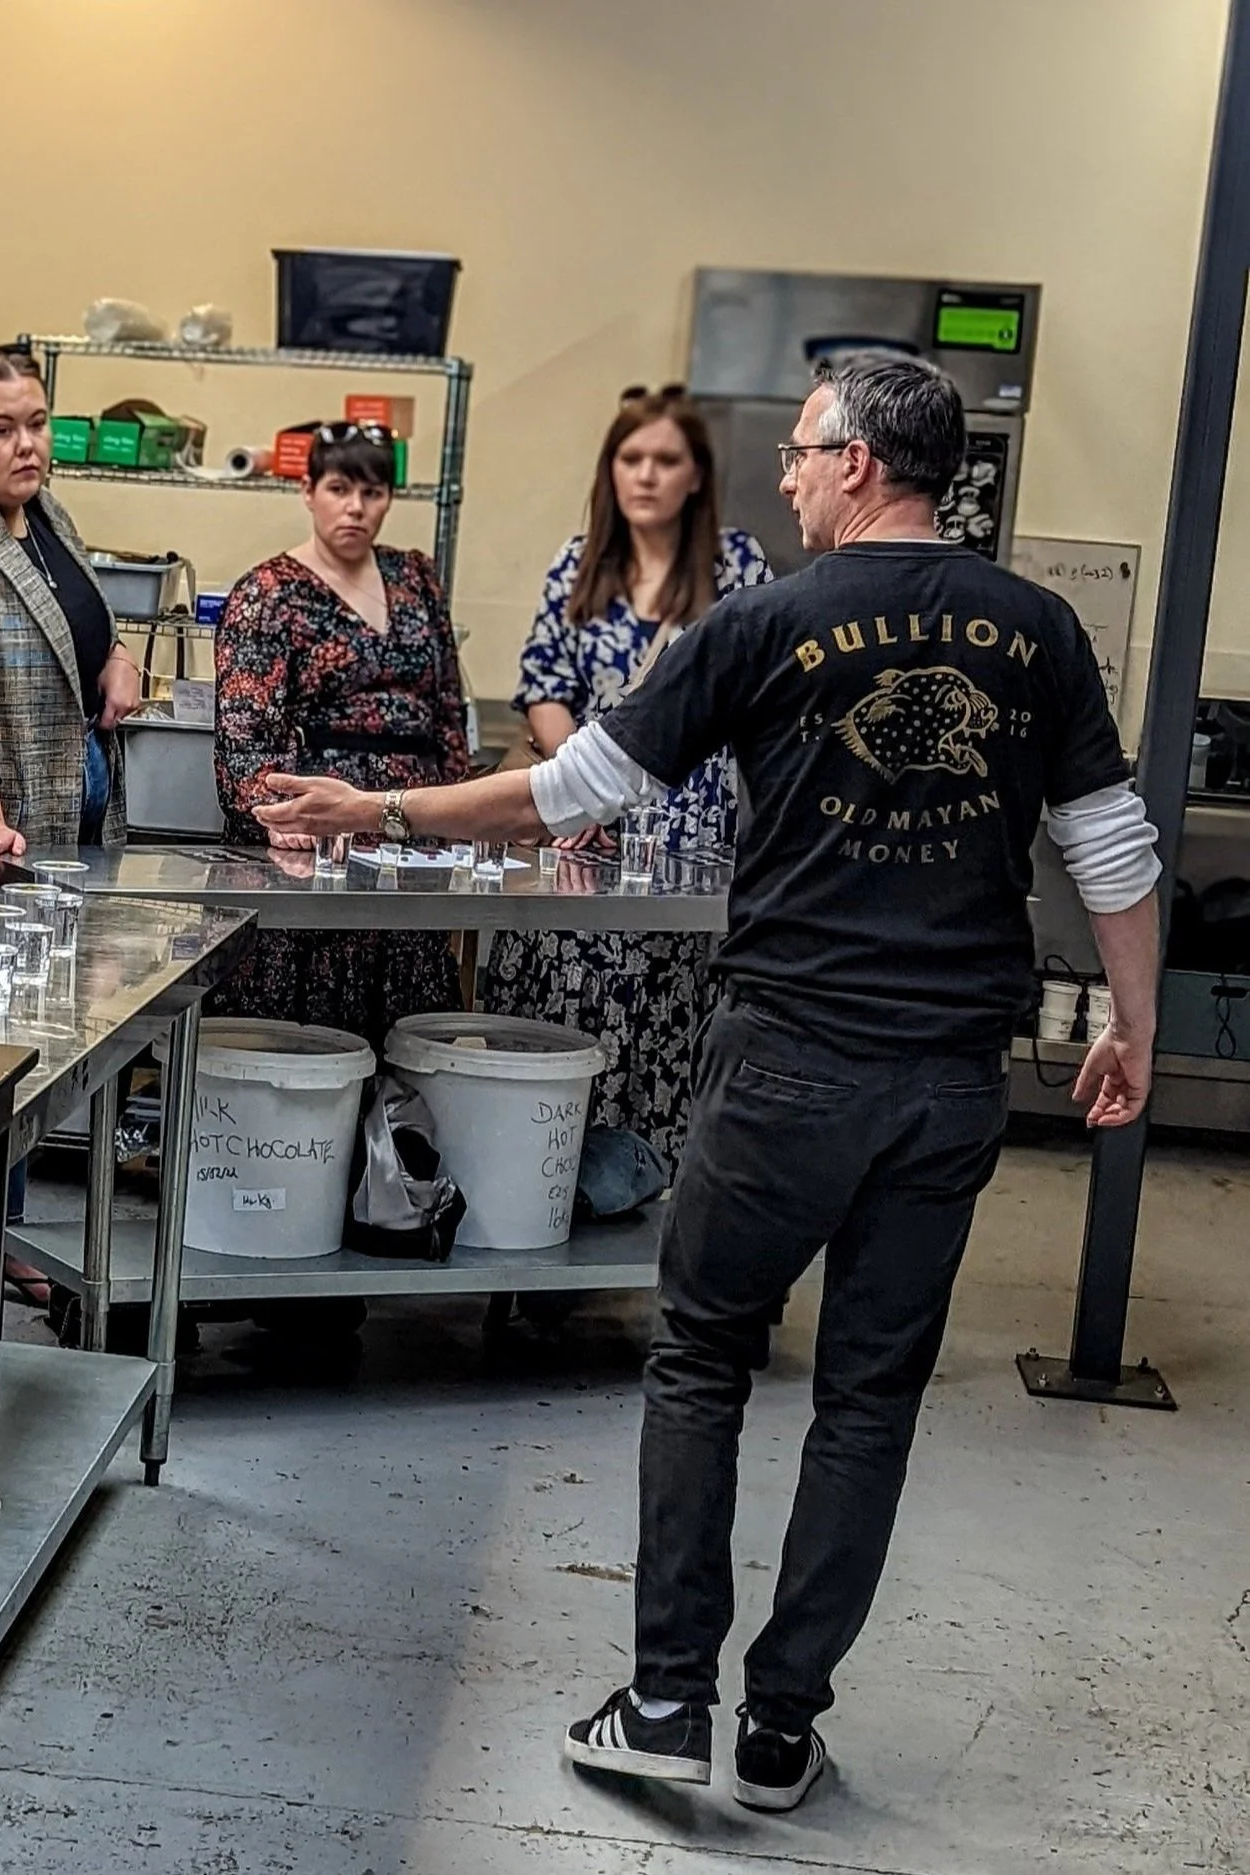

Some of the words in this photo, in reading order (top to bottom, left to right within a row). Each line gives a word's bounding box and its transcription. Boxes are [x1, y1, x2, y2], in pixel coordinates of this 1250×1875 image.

[794, 613, 1039, 673] BULLION
[1009, 708, 1032, 723] 20
[1009, 724, 1028, 738] 16
[819, 795, 877, 827] OLD
[886, 789, 1003, 831] MAYAN
[837, 838, 962, 864] MONEY
[530, 1101, 582, 1124] DARK
[225, 1135, 335, 1165] CHOCOLATE
[548, 1127, 578, 1151] HOT
